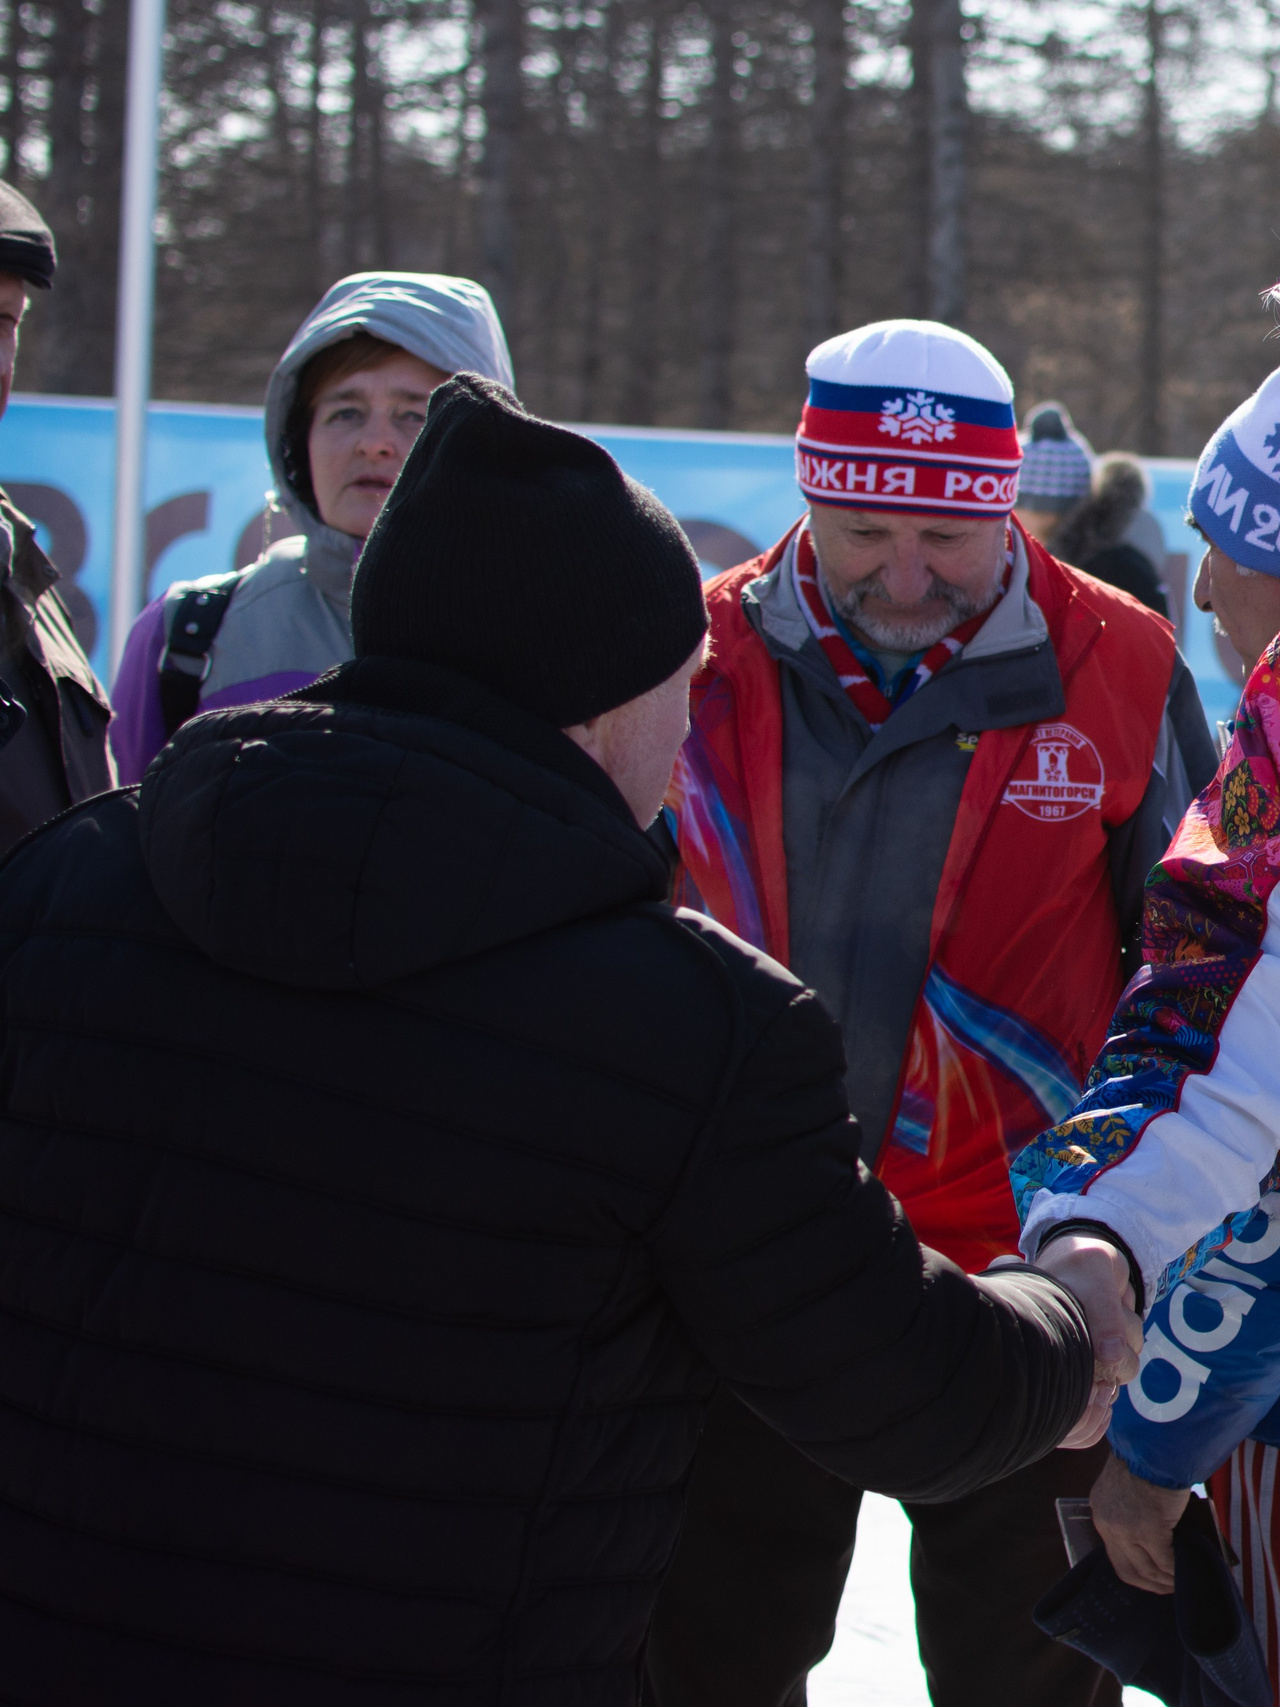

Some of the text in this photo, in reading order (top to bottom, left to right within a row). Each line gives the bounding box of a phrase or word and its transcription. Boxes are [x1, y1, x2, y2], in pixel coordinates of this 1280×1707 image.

[799, 455, 1018, 502] ЫЖНЯ РОСС
[1008, 784, 1096, 799] МАГНИТОГОРСК
[1039, 805, 1066, 817] 1967
